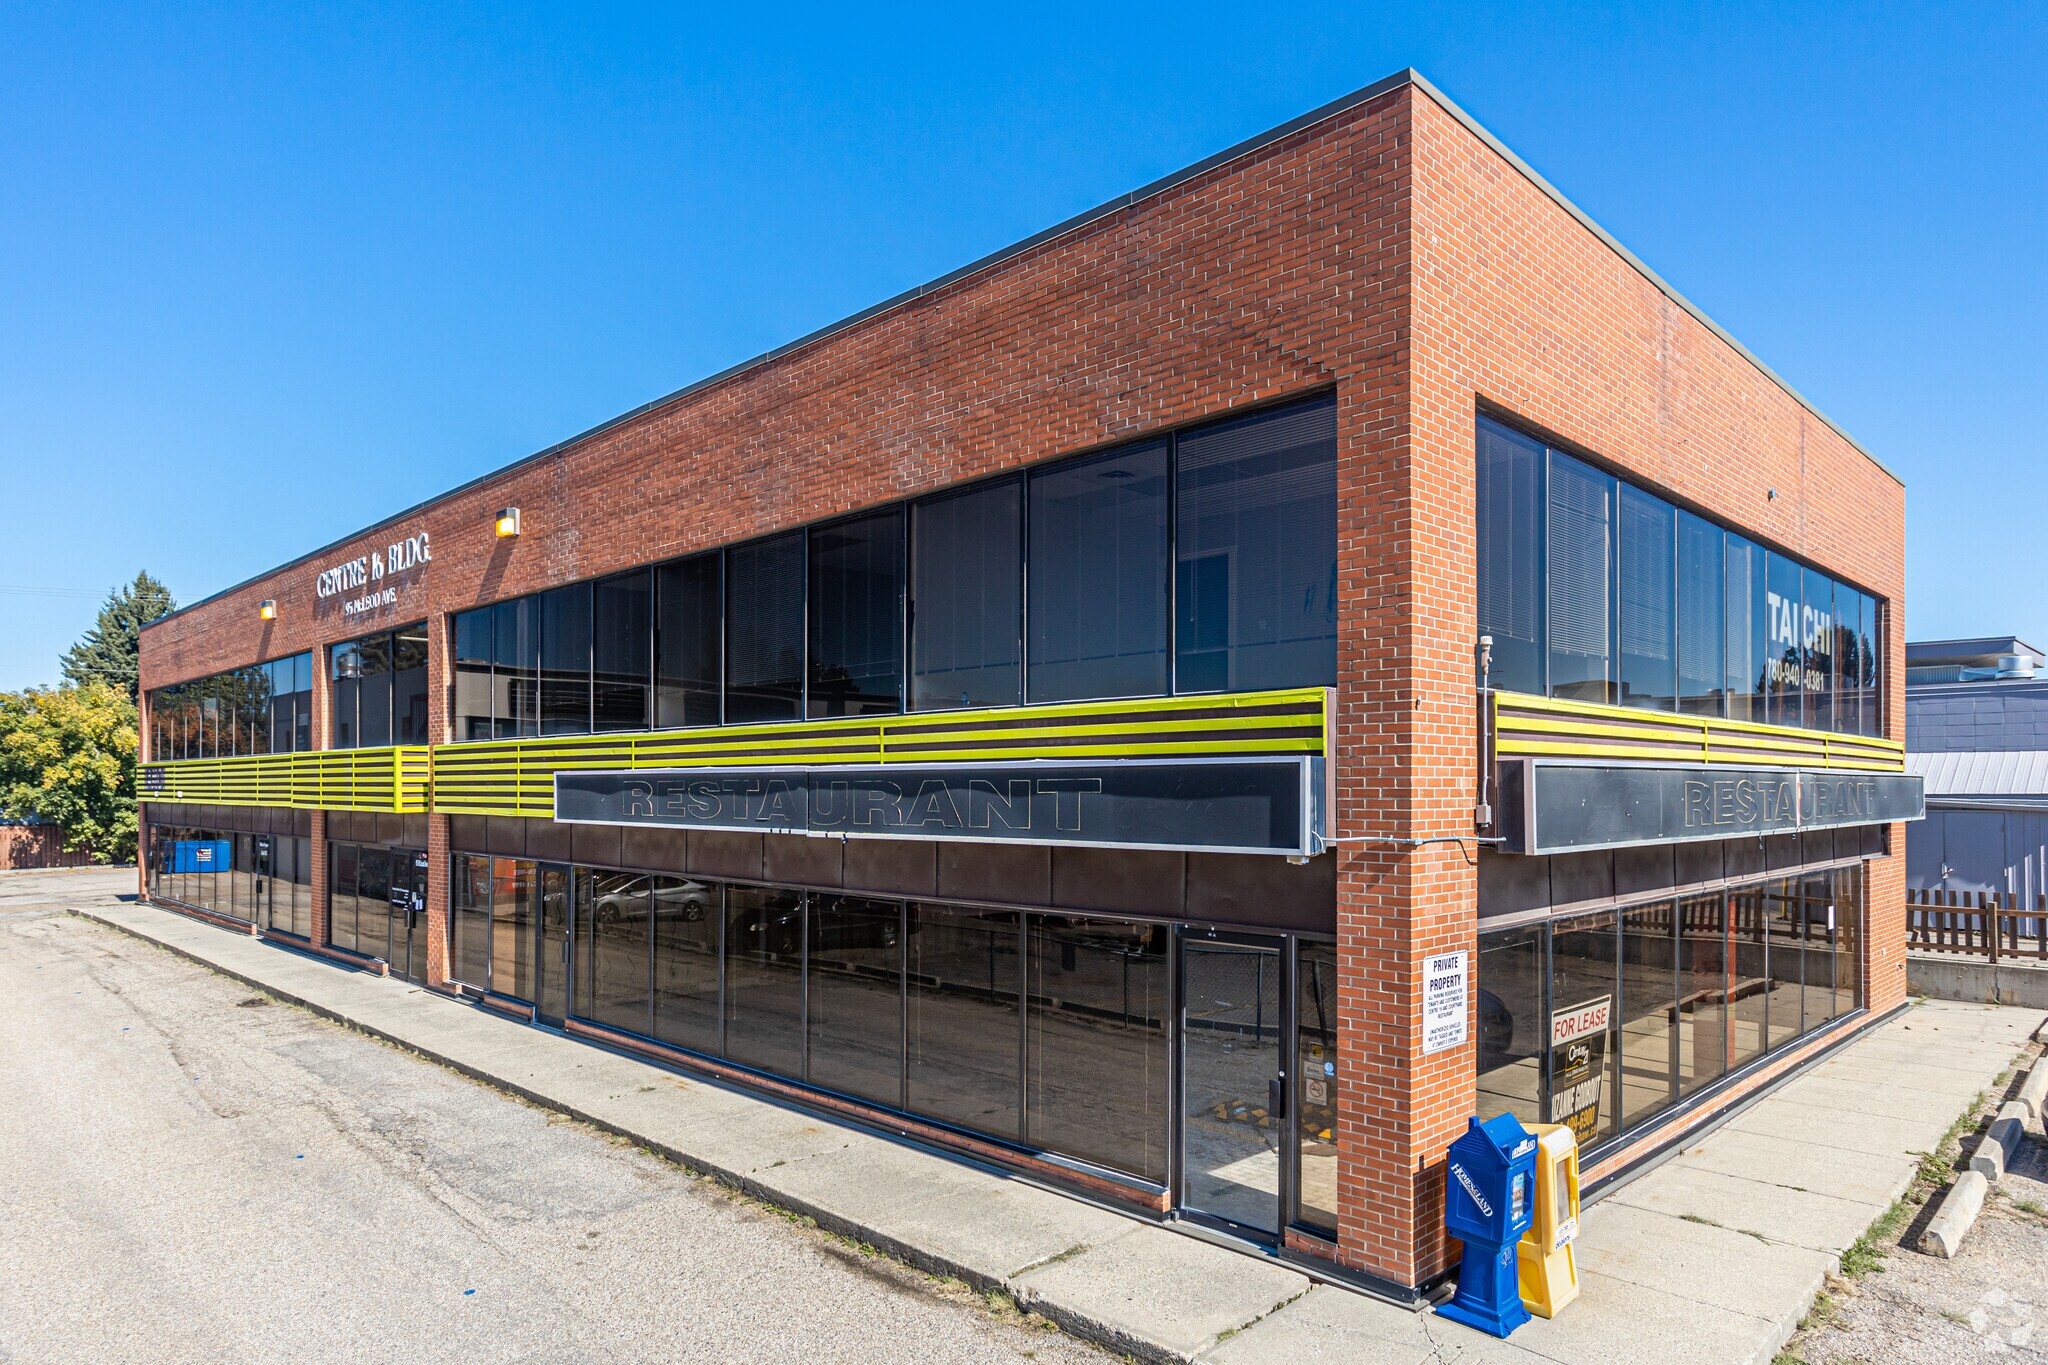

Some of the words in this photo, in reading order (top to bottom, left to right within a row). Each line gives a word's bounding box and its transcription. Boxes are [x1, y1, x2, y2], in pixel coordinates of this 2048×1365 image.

[316, 557, 367, 599] CENTRE
[371, 552, 384, 580] 16
[1767, 591, 1799, 648] TAI
[1803, 605, 1831, 656] CHI
[622, 777, 1102, 832] RESTAURANT
[1684, 779, 1875, 828] RESTAURANT
[1430, 974, 1461, 991] PROPERTY
[1433, 957, 1458, 972] PRIVATE
[1553, 1017, 1575, 1041] FOR
[1577, 1007, 1607, 1034] LEASE
